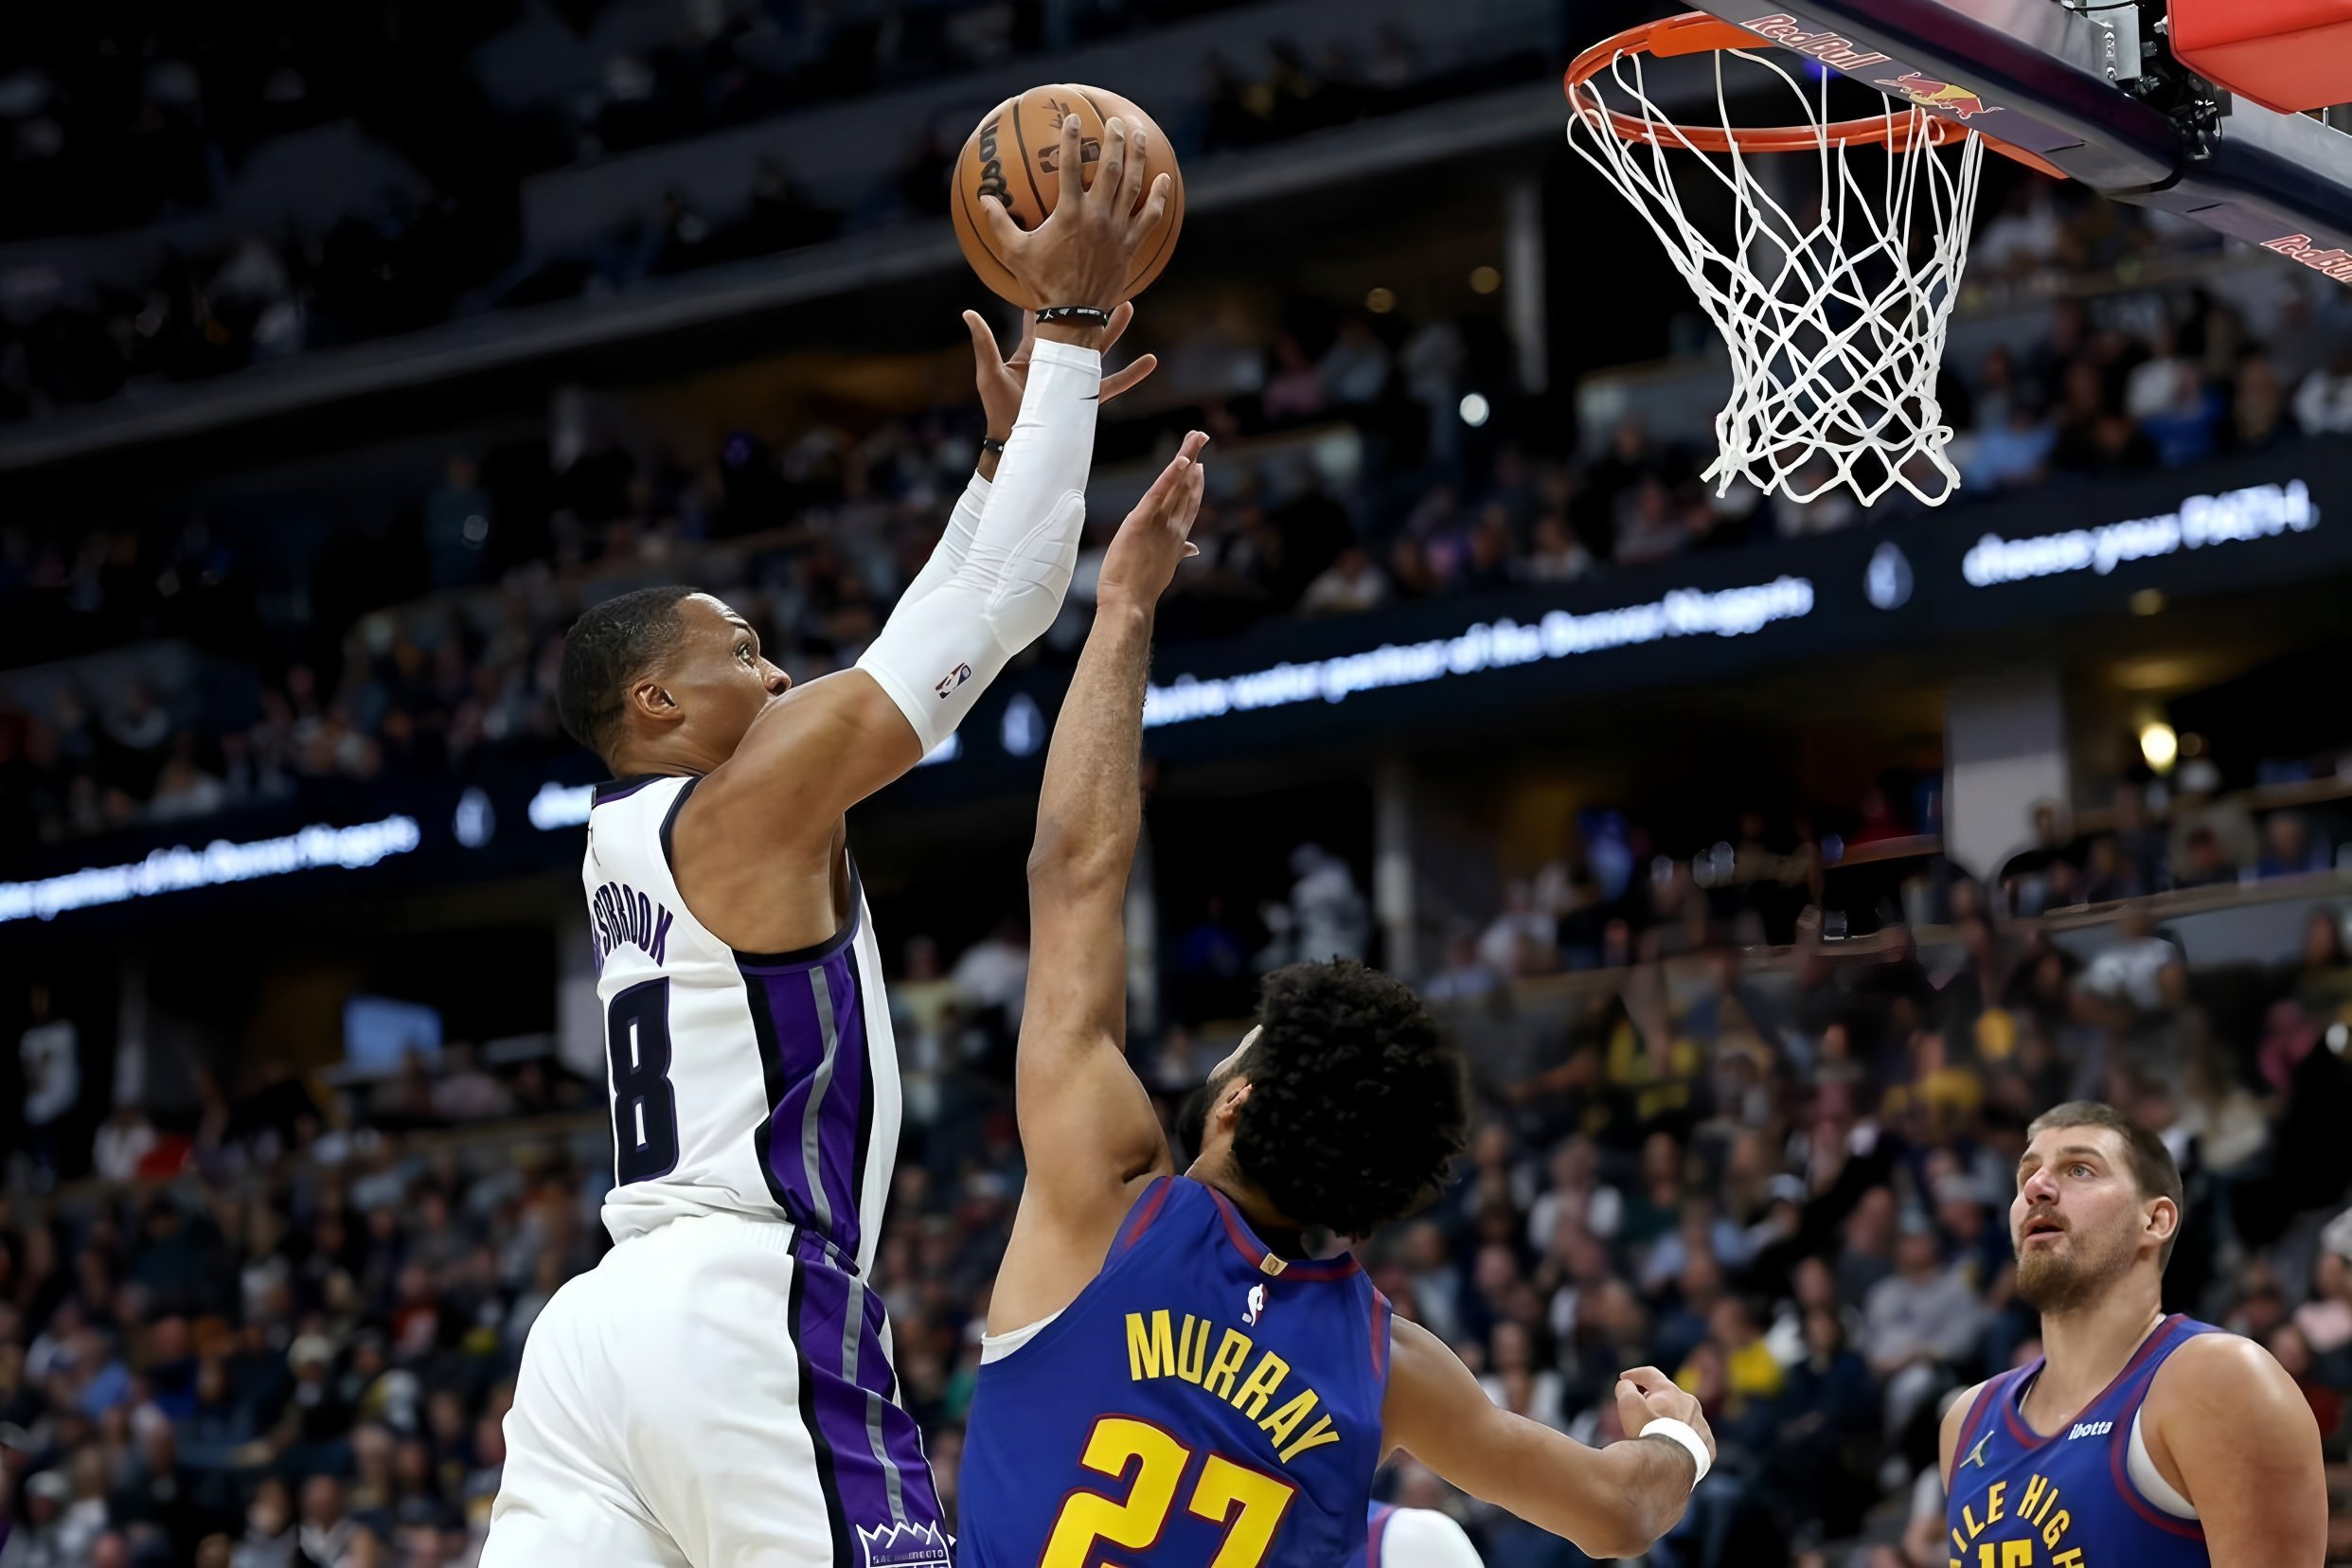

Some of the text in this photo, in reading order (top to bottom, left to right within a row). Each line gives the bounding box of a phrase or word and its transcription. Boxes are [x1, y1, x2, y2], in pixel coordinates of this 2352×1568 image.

[1125, 1309, 1341, 1464] MURRAY
[1037, 1413, 1299, 1568] 27
[1950, 1480, 2007, 1568] ILE
